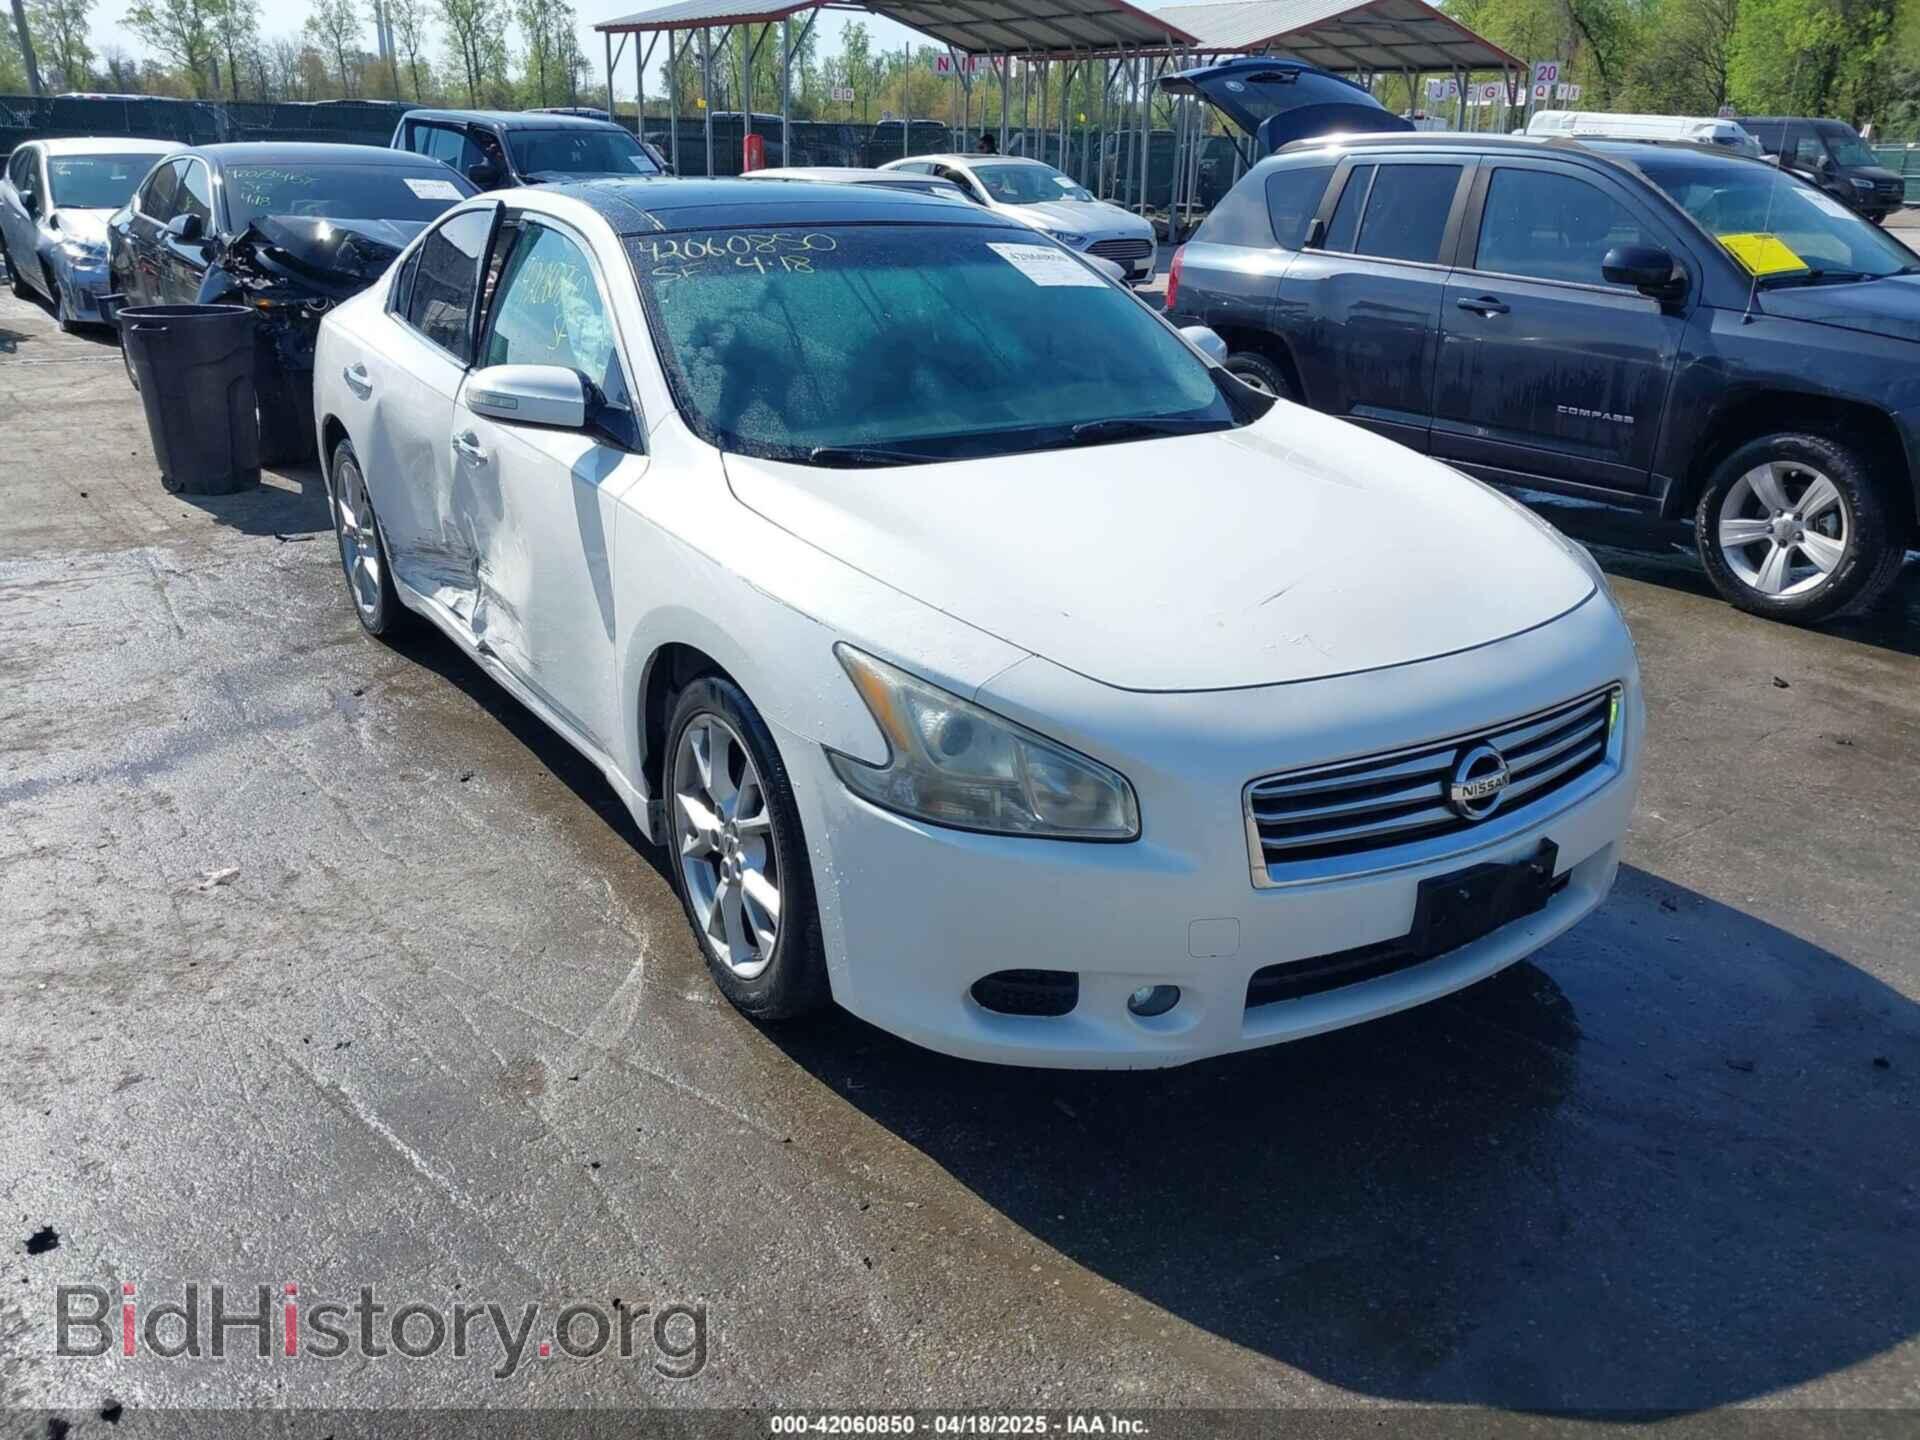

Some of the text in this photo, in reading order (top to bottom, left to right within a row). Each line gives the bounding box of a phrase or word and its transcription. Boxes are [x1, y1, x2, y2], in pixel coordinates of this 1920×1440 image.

[937, 57, 949, 71] N
[1537, 65, 1557, 81] 20
[1484, 86, 1496, 98] G
[1535, 85, 1546, 97] Q
[639, 233, 837, 261] 42060850
[1557, 405, 1634, 423] COMPASS
[1462, 776, 1509, 797] NISSAN
